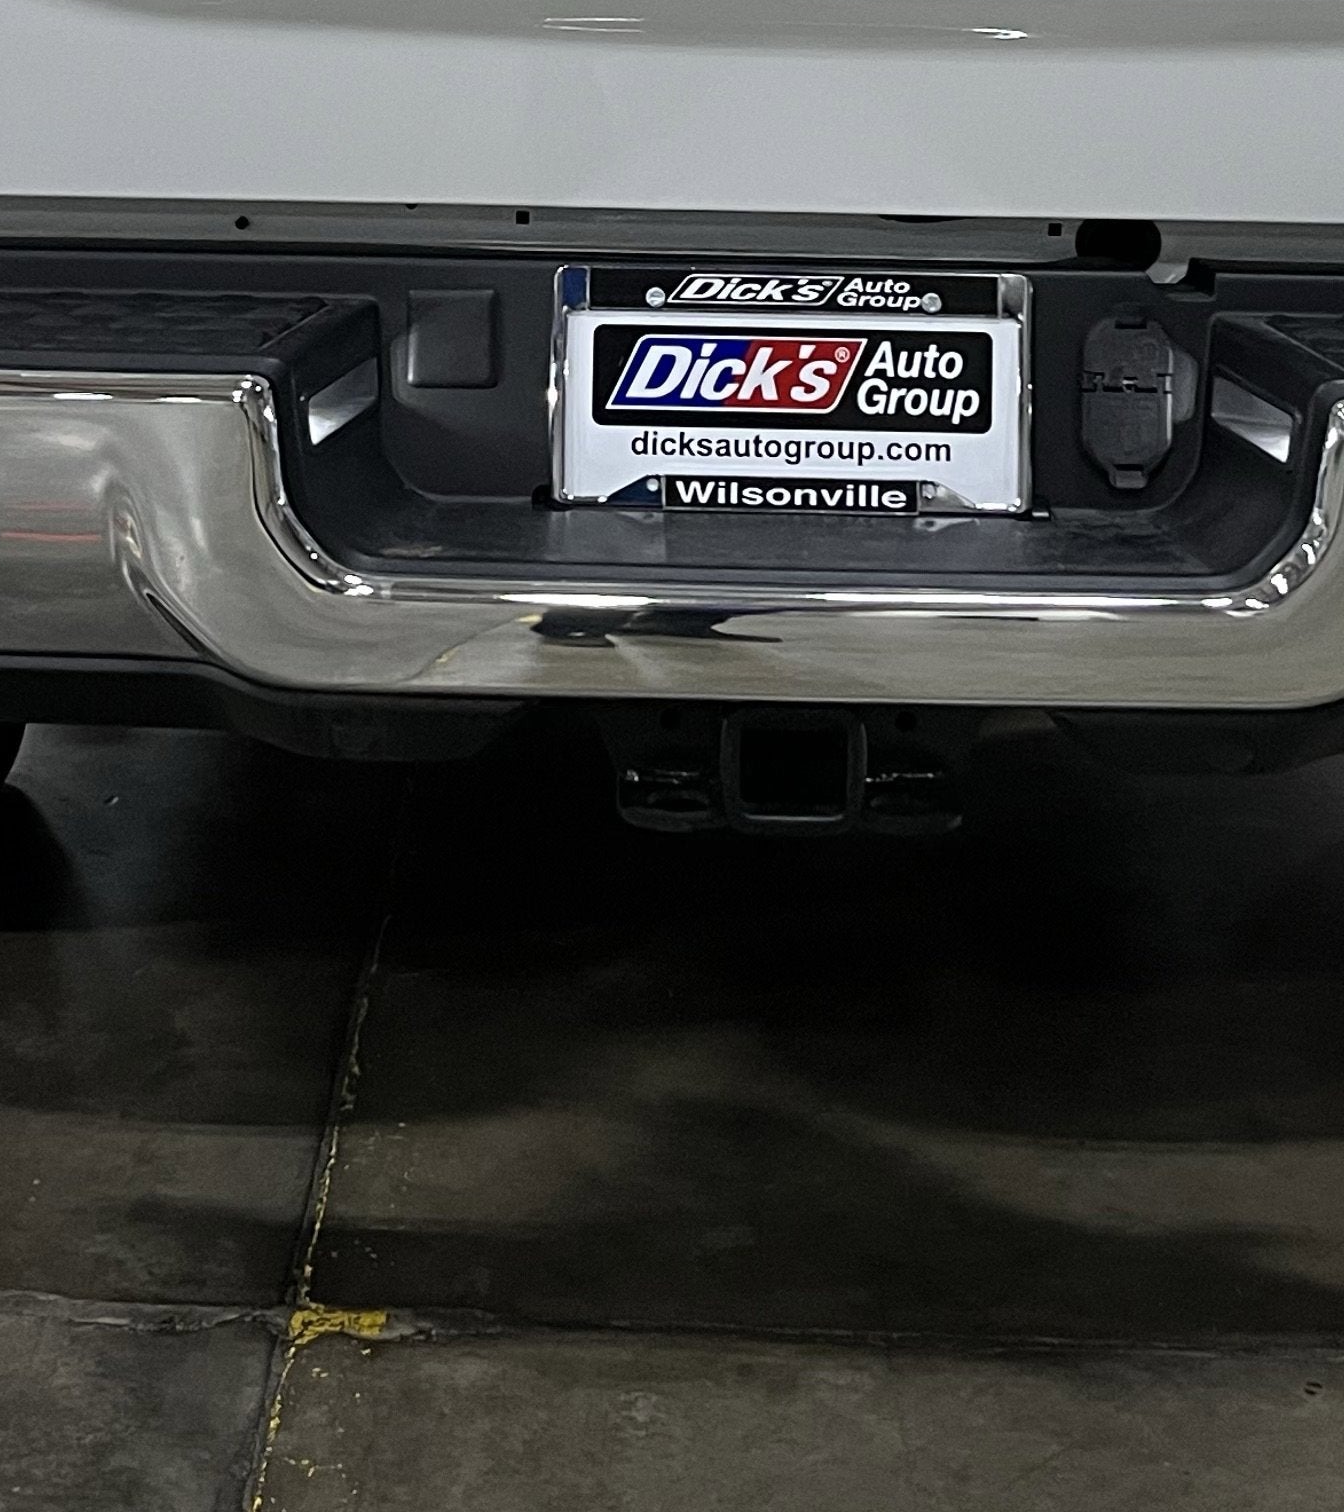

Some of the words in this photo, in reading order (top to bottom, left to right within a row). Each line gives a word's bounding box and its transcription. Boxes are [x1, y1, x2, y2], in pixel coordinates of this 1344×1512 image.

[679, 276, 828, 302] Dick's
[842, 276, 911, 294] Auto
[836, 291, 921, 311] Group
[624, 341, 840, 403] Dick's
[864, 340, 964, 380] Auto
[857, 380, 980, 425] Group
[630, 430, 952, 466] dicksautogroup.com
[675, 479, 908, 509] Wilsonville
